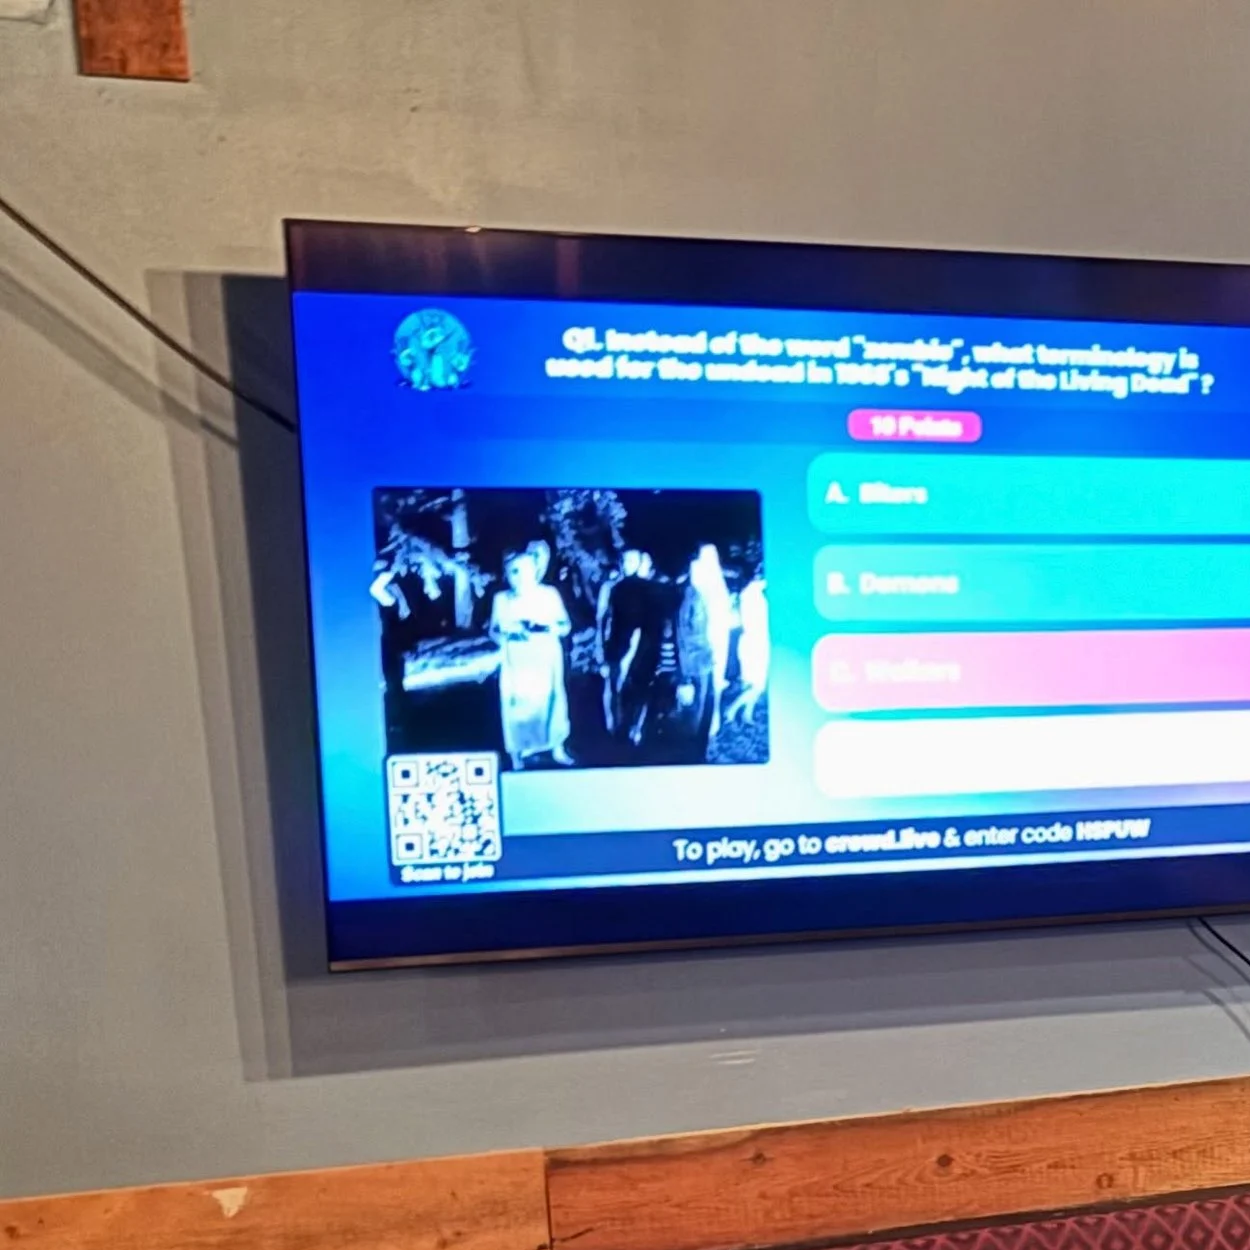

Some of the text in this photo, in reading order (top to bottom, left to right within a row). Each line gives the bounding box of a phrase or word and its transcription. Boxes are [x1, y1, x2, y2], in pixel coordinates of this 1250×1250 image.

[708, 331, 737, 353] of
[738, 332, 784, 356] the
[1179, 348, 1199, 369] is
[614, 355, 656, 379] for
[656, 357, 703, 381] the
[806, 360, 833, 383] in
[990, 367, 1017, 389] of
[1017, 369, 1057, 390] the
[1059, 369, 1128, 399] Living
[825, 482, 849, 504] A.
[672, 839, 703, 861] To
[706, 837, 761, 865] play,
[763, 838, 795, 862] go
[797, 835, 822, 855] to
[942, 827, 961, 848] &
[963, 826, 1019, 847] enter
[1020, 822, 1074, 844] code
